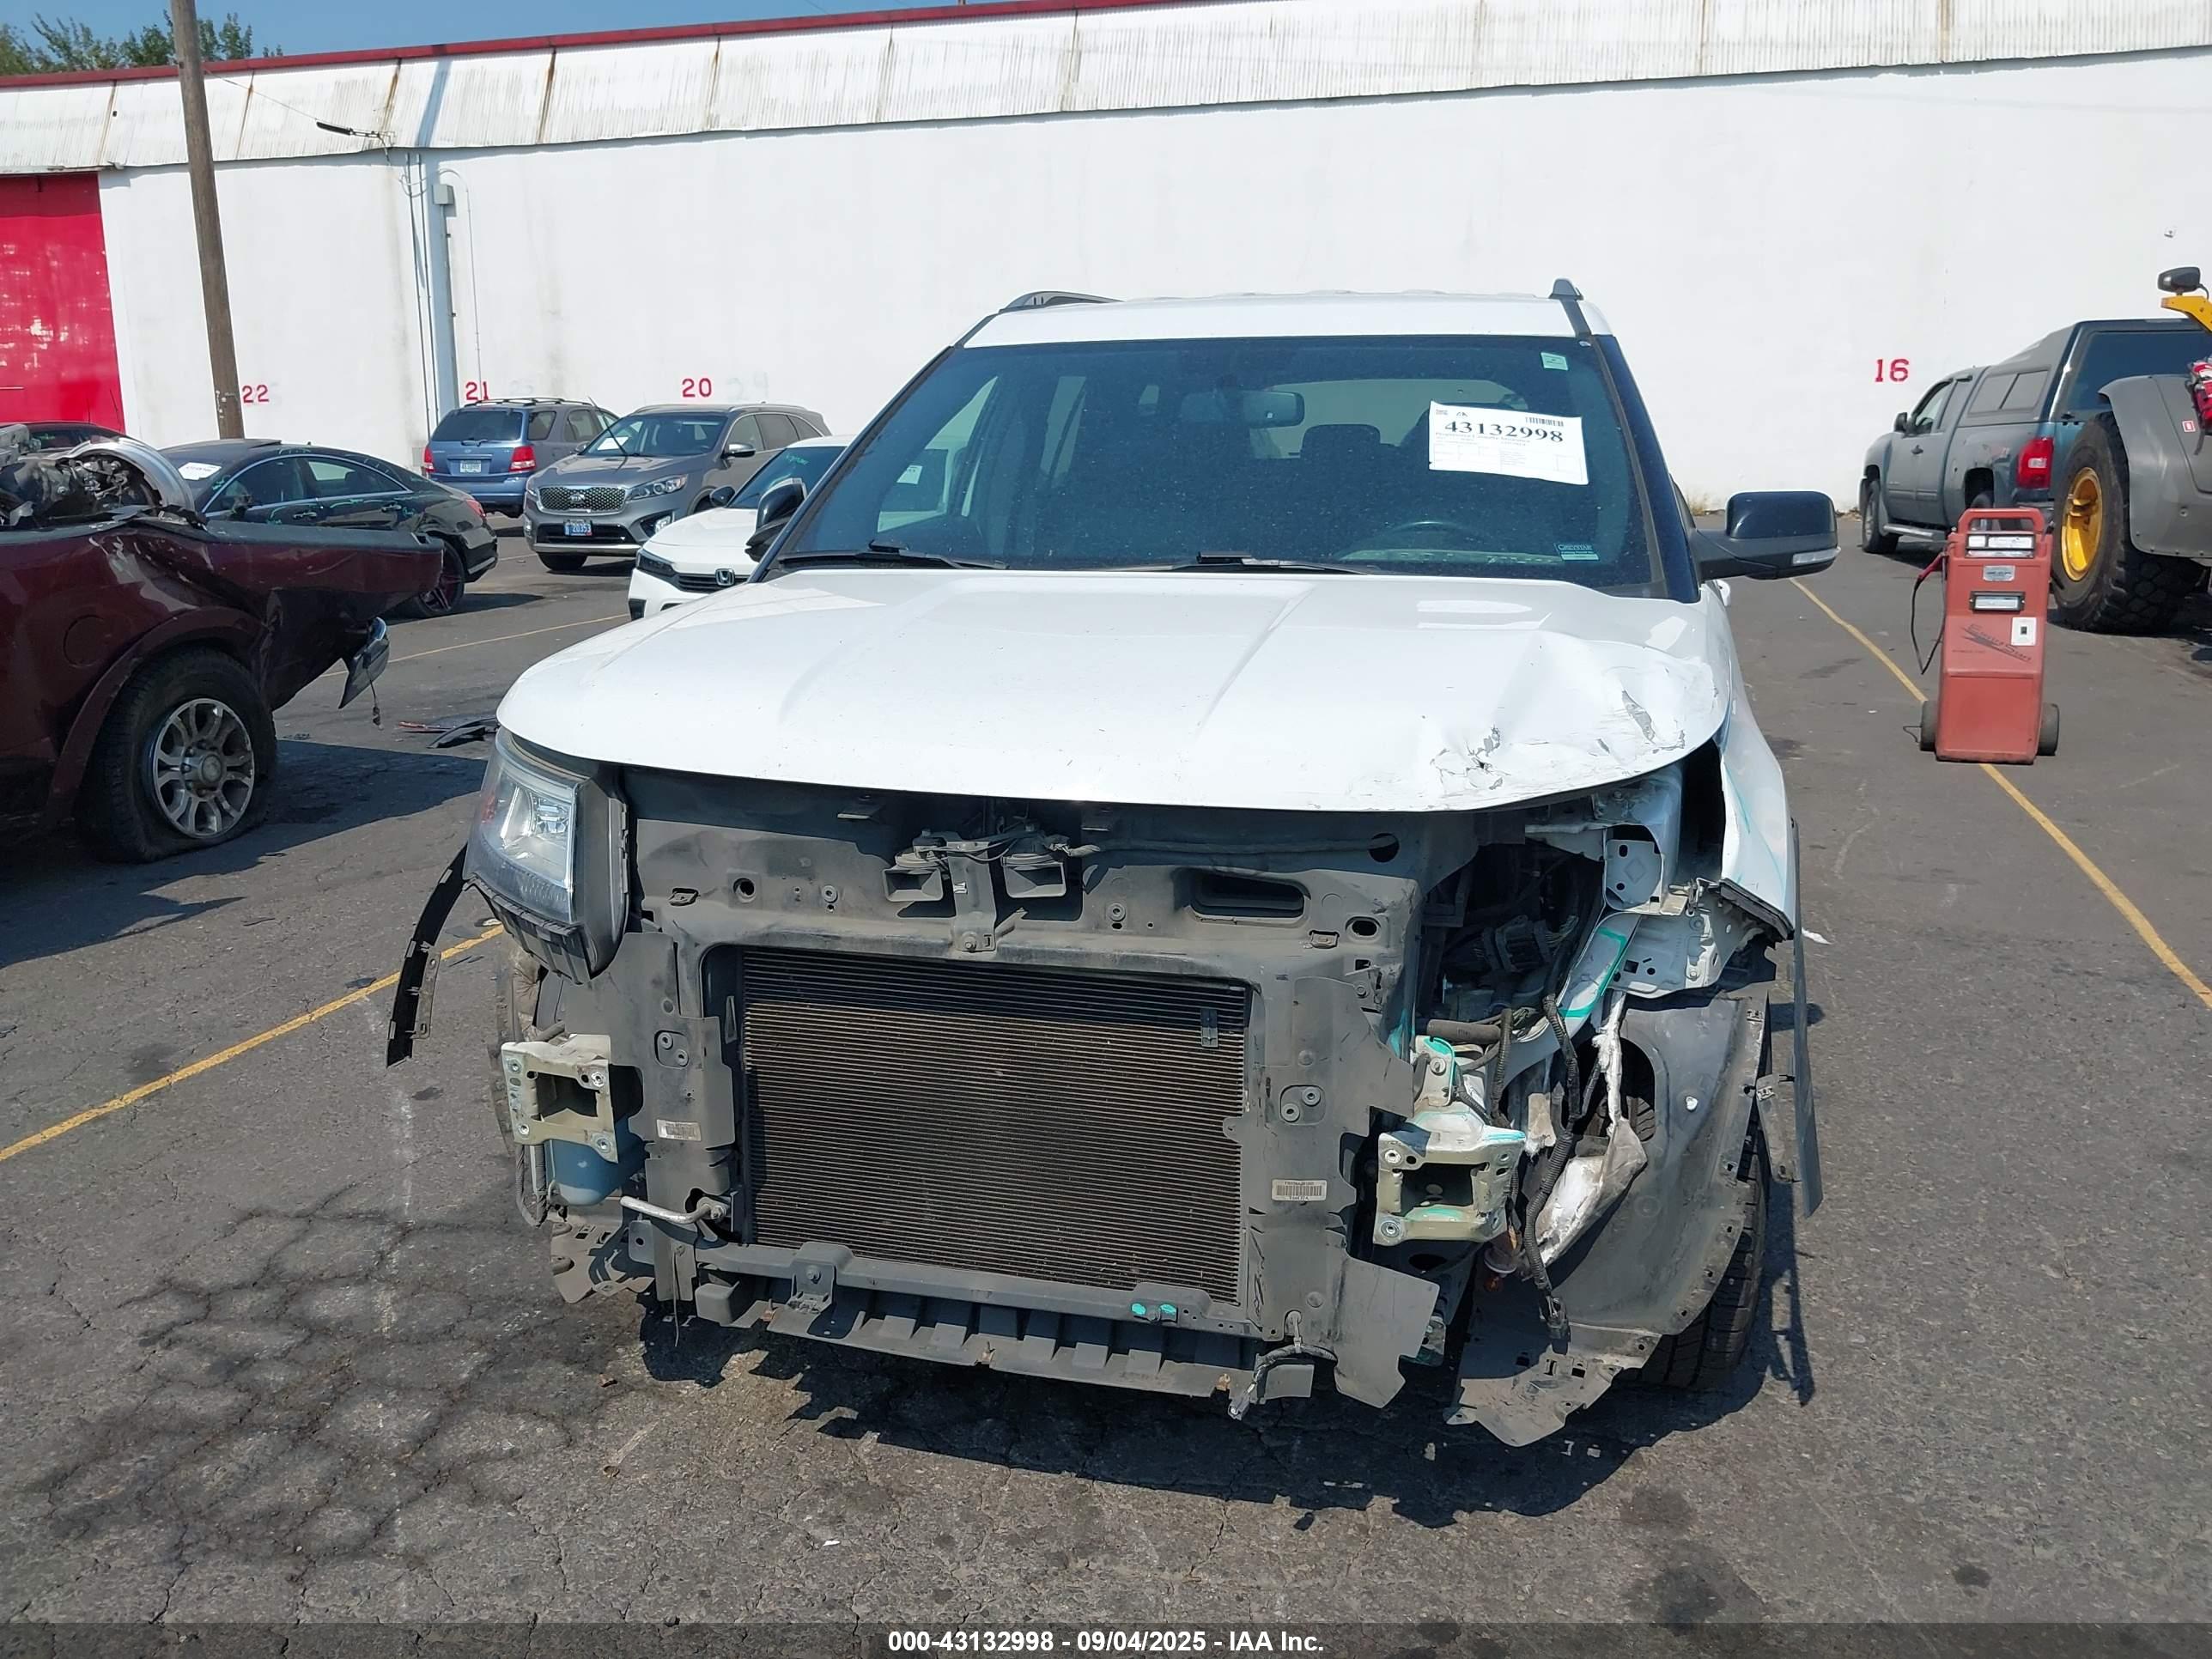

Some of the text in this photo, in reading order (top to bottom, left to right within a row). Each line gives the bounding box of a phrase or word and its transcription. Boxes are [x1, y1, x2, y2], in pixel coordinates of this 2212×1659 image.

[1875, 359, 1910, 382] 16
[242, 384, 270, 404] 22
[465, 381, 489, 400] 21
[682, 378, 712, 398] 20
[1444, 421, 1564, 443] 43132998
